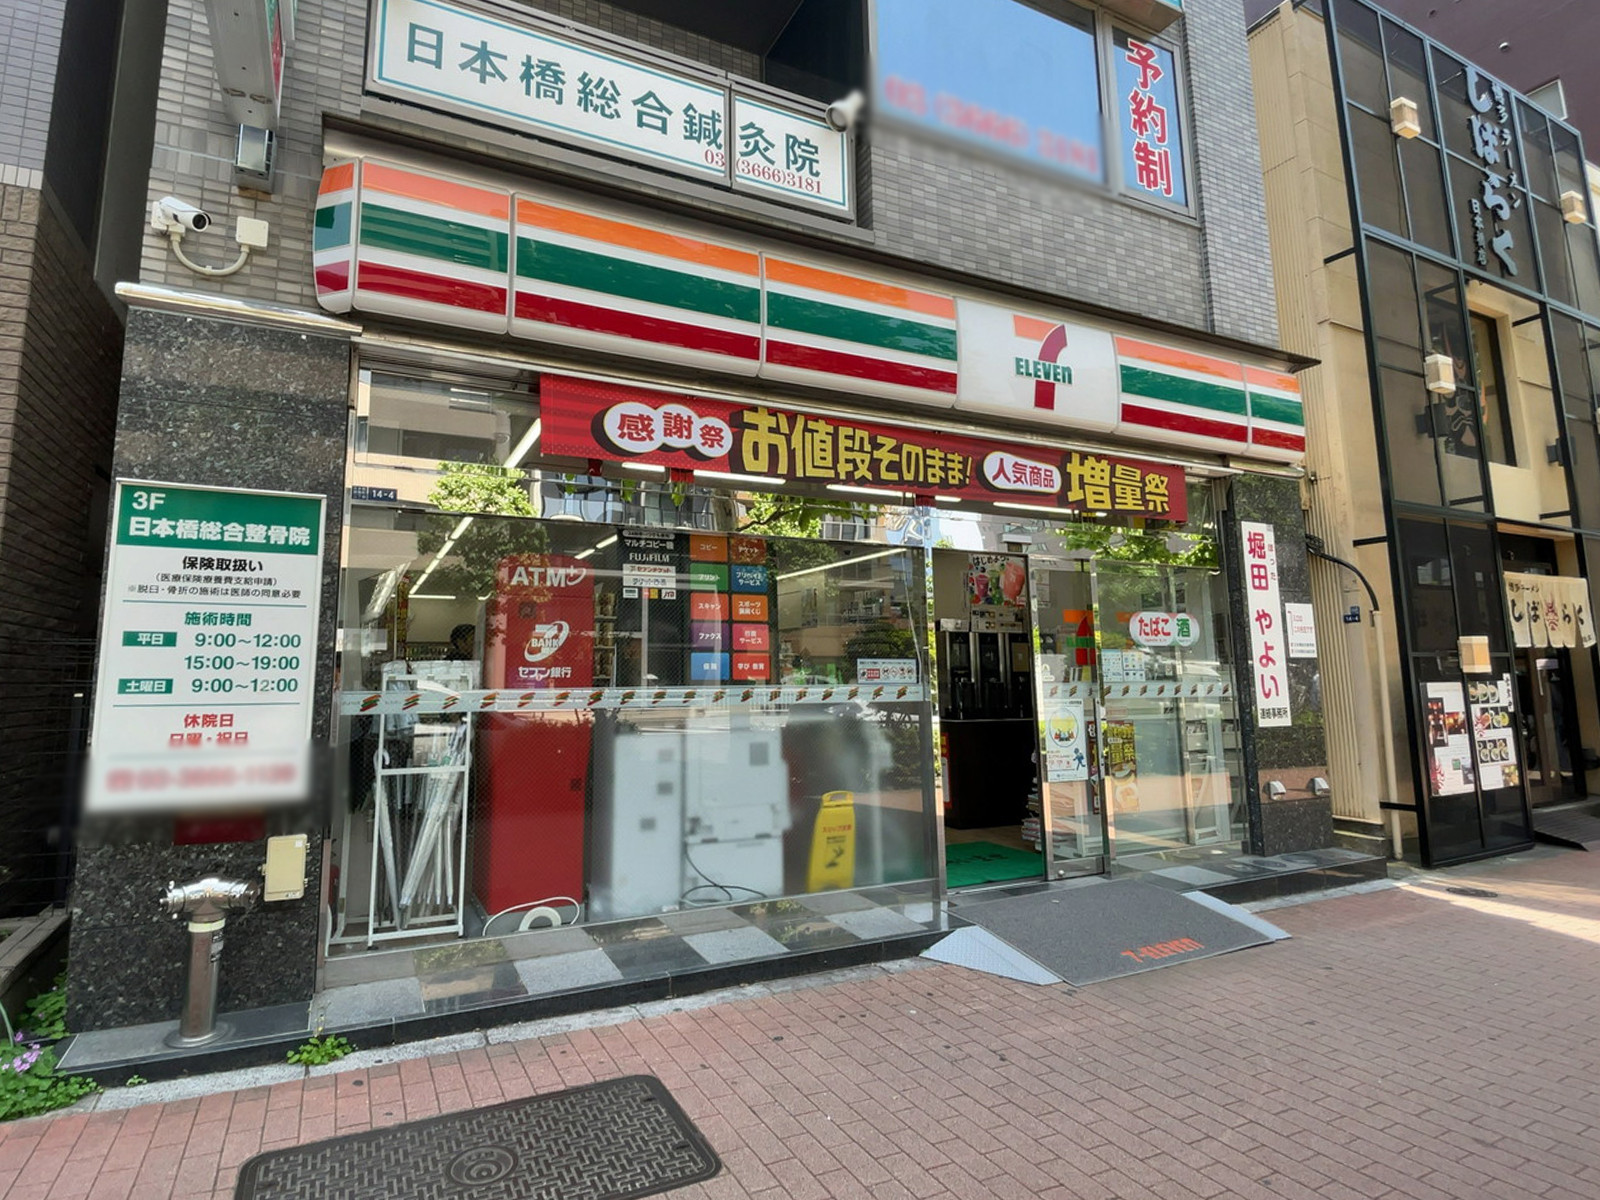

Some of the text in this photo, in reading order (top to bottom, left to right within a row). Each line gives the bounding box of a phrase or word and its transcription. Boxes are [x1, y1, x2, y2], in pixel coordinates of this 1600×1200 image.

[407, 22, 821, 178] 日本橋総合鍼灸院
[1126, 39, 1173, 197] 予約制
[704, 149, 822, 194] 03 (3666)3181
[617, 406, 1171, 513] 感謝祭 お値段そのまま! 人気商品 増量祭
[132, 491, 166, 511] 3F
[372, 489, 394, 499] 14-4
[129, 516, 311, 547] 日本橋総合整骨院
[182, 556, 264, 573] 保険取扱い
[510, 566, 567, 588] ATM
[698, 602, 722, 611] スキャン
[1247, 531, 1280, 700] 堀田 やよい
[184, 611, 252, 627] 施術時間
[1138, 616, 1172, 637] たばこ
[1176, 617, 1191, 638] 酒
[136, 631, 302, 649] 平日 9:00～12:00
[531, 638, 560, 648] BANK
[698, 632, 722, 640] ファクス
[184, 655, 301, 671] 15:00～19:00
[518, 666, 572, 680] セブン銀行
[125, 678, 299, 694] 土曜日 9:00～12:00
[184, 713, 234, 729] 休院日
